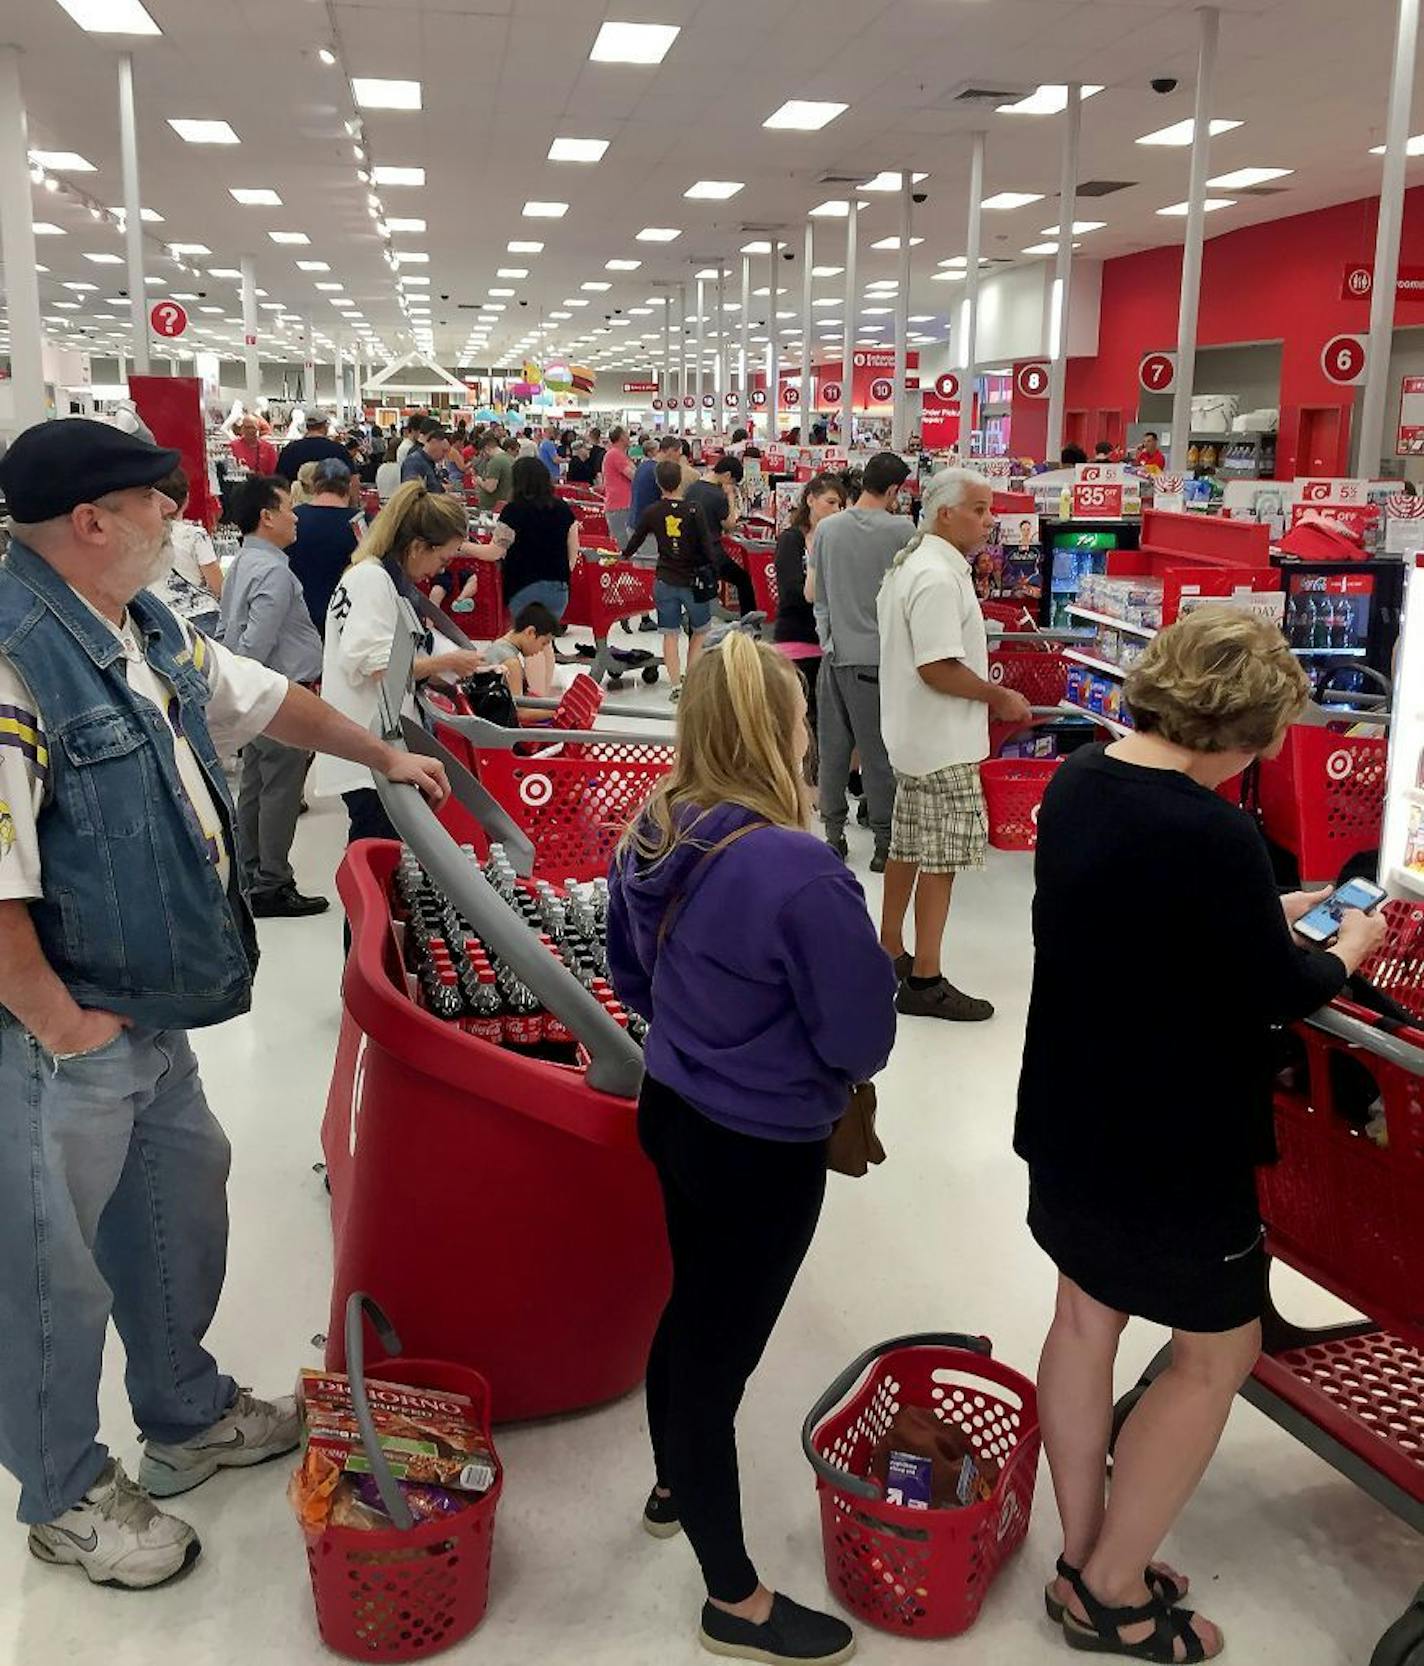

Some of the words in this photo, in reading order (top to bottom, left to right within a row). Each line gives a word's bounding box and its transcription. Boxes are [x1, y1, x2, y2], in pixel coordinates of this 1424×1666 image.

[1336, 349, 1352, 371] 6
[1151, 364, 1165, 383] 7
[942, 379, 954, 393] 9
[1028, 372, 1040, 389] 8
[785, 390, 797, 401] 12
[826, 388, 838, 399] 11
[875, 385, 889, 396] 10
[753, 393, 764, 403] 13
[1076, 486, 1105, 506] $35
[1105, 488, 1118, 497] OFF
[1337, 512, 1357, 521] OFF
